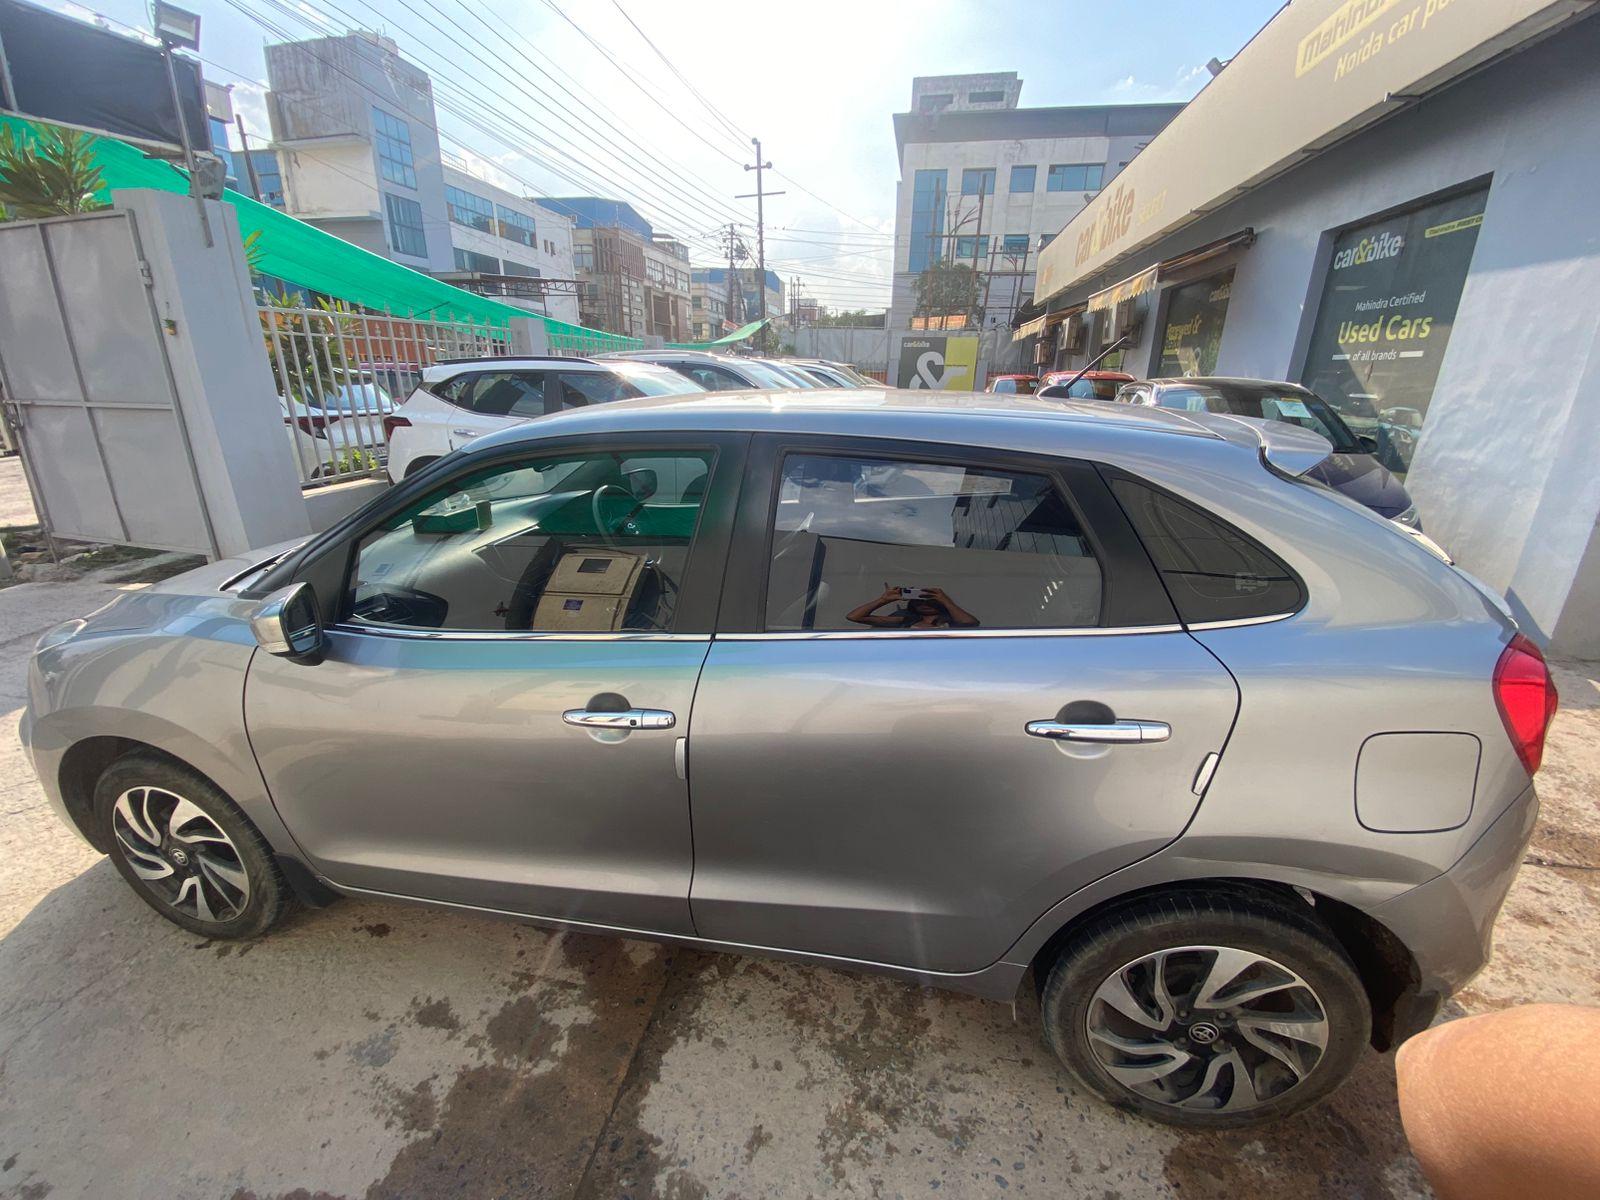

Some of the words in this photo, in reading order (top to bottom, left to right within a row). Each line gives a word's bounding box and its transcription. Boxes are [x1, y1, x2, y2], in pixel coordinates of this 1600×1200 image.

[1334, 31, 1384, 82] Noida
[1388, 6, 1421, 44] car
[1333, 231, 1402, 270] car&bike
[1354, 299, 1389, 312] Mahindra
[1389, 291, 1427, 307] Certified
[1338, 315, 1384, 344] Used
[1385, 315, 1433, 341] Cars
[1352, 350, 1362, 361] of
[1362, 350, 1371, 361] all
[1371, 350, 1397, 361] brands
